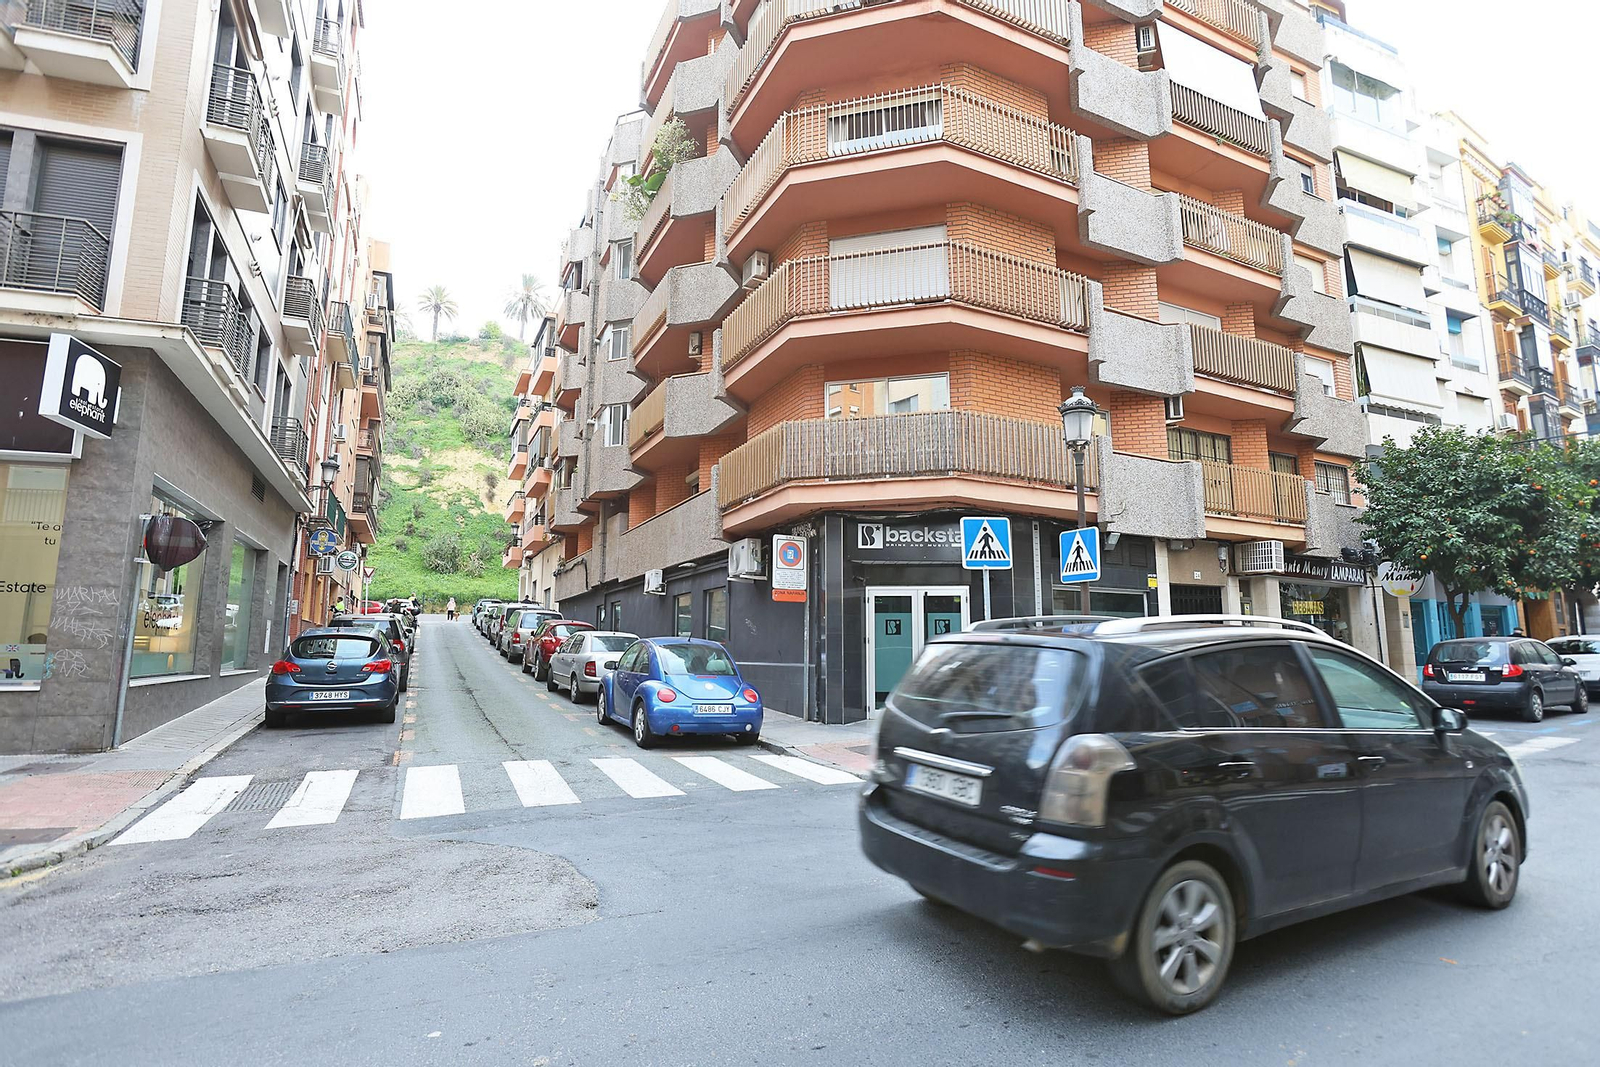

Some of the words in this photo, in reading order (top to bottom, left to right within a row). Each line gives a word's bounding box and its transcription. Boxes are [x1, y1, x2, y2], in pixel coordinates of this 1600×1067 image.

[69, 398, 105, 423] elephant
[885, 526, 962, 543] backsta
[44, 537, 56, 546] tu
[1284, 560, 1301, 574] ante
[1331, 566, 1365, 583] LAMPARAS
[0, 580, 47, 593] Estate
[1293, 601, 1325, 614] REBAJAS
[699, 705, 716, 713] 6486
